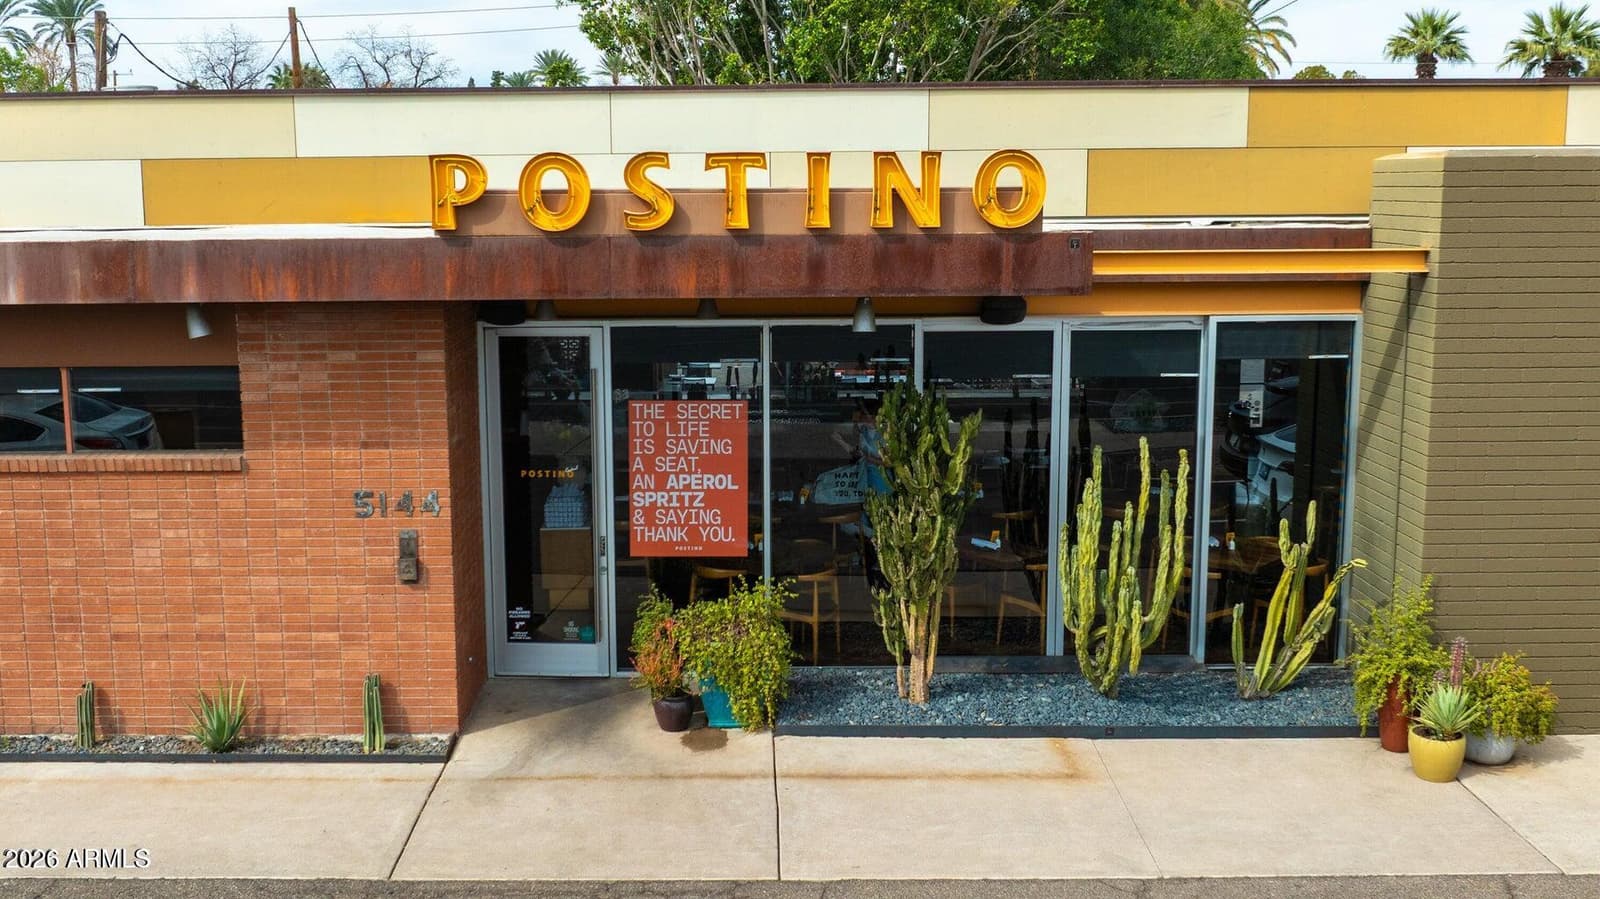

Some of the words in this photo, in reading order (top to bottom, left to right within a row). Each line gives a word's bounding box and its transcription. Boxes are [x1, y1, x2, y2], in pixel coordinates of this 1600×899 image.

[430, 149, 1047, 232] POSTINO
[632, 403, 665, 419] THE
[677, 403, 743, 419] SECRET
[632, 421, 655, 437] TO
[666, 421, 710, 437] LIFE
[633, 439, 655, 455] IS
[666, 439, 732, 455] SAVING
[520, 469, 575, 478] POSTINO
[632, 457, 644, 472] A
[655, 457, 702, 474] SEAT,
[632, 474, 655, 489] AN
[353, 489, 440, 518] 5144
[632, 491, 705, 507] SPRITZ
[633, 509, 645, 525] &
[655, 509, 721, 524] SAYING
[634, 526, 688, 542] THANK
[699, 526, 736, 542] YOU.
